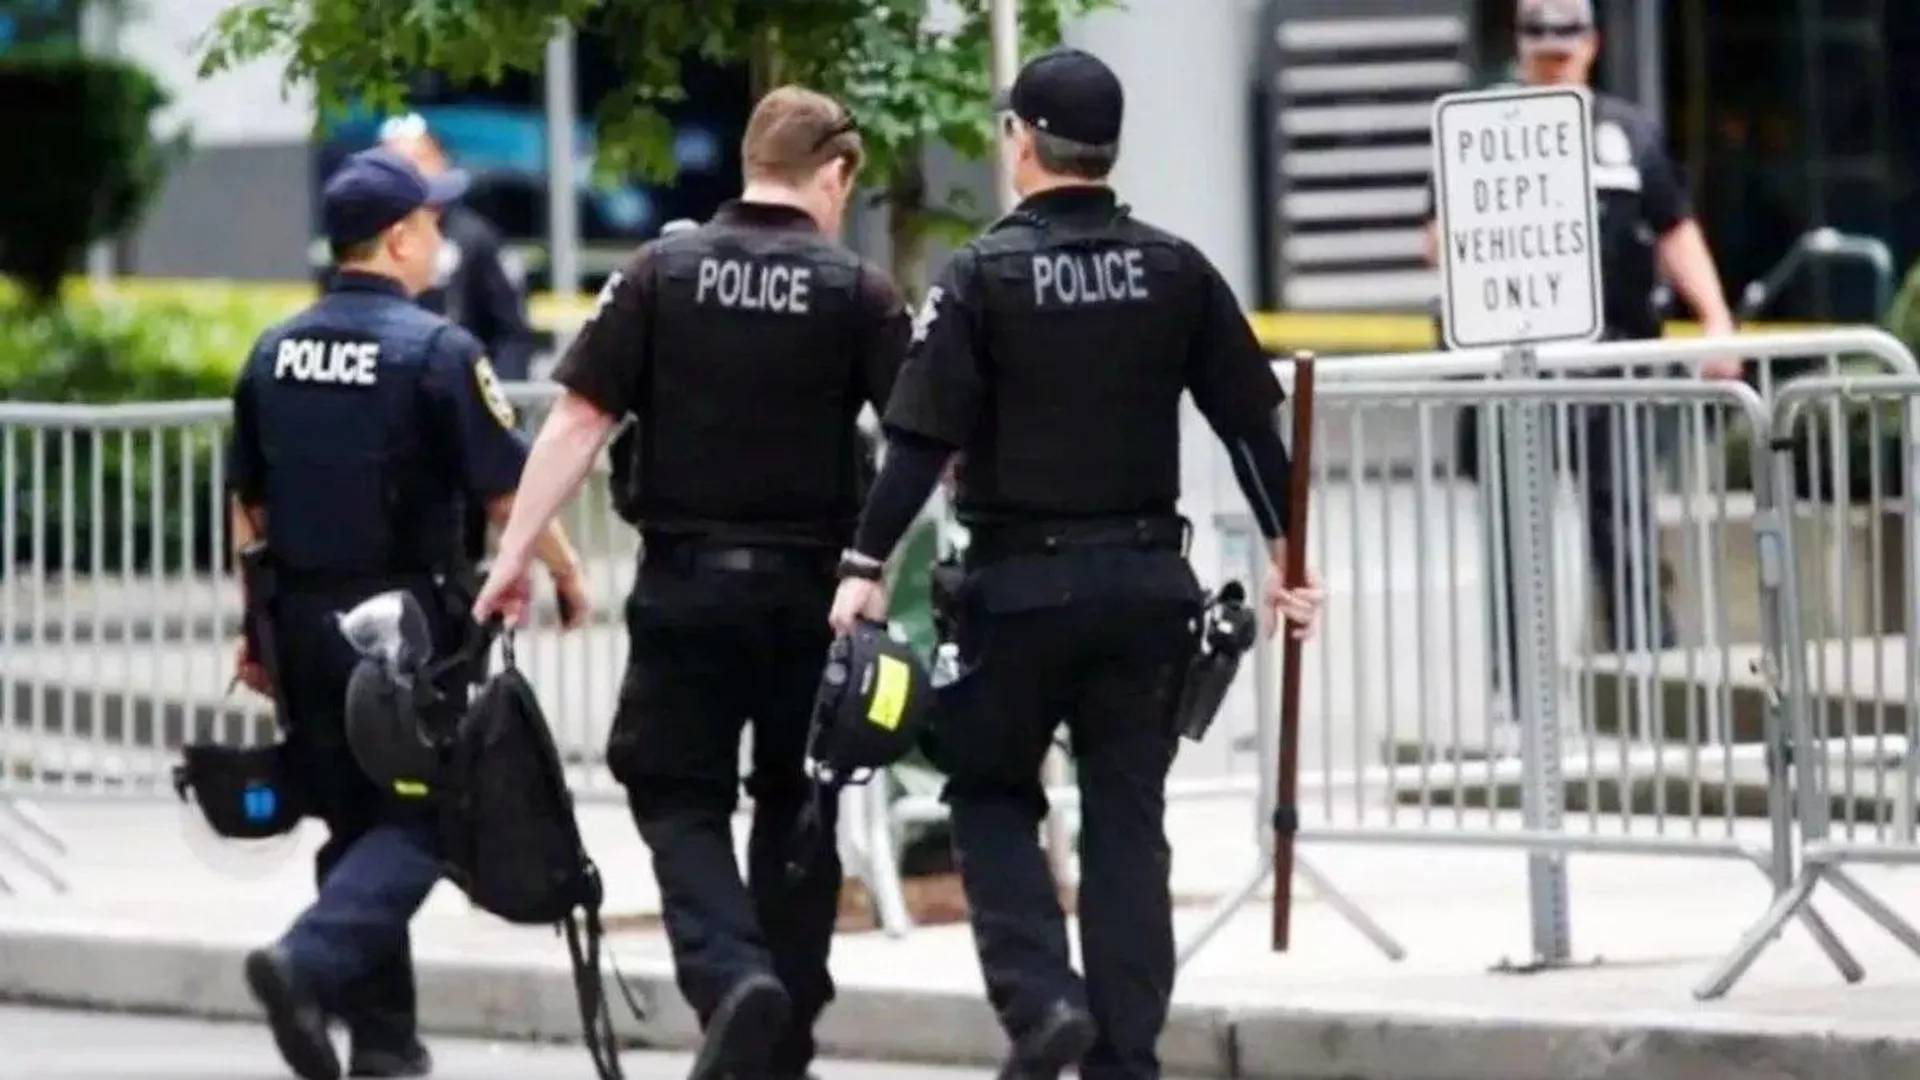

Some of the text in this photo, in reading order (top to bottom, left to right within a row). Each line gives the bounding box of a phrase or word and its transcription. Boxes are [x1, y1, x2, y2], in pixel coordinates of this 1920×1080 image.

[1458, 121, 1569, 164] POLICE
[1454, 219, 1584, 264] VEHICLES
[697, 257, 811, 313] POLICE
[1032, 249, 1149, 305] POLICE
[1483, 272, 1562, 311] ONLY
[275, 338, 380, 385] POLICE
